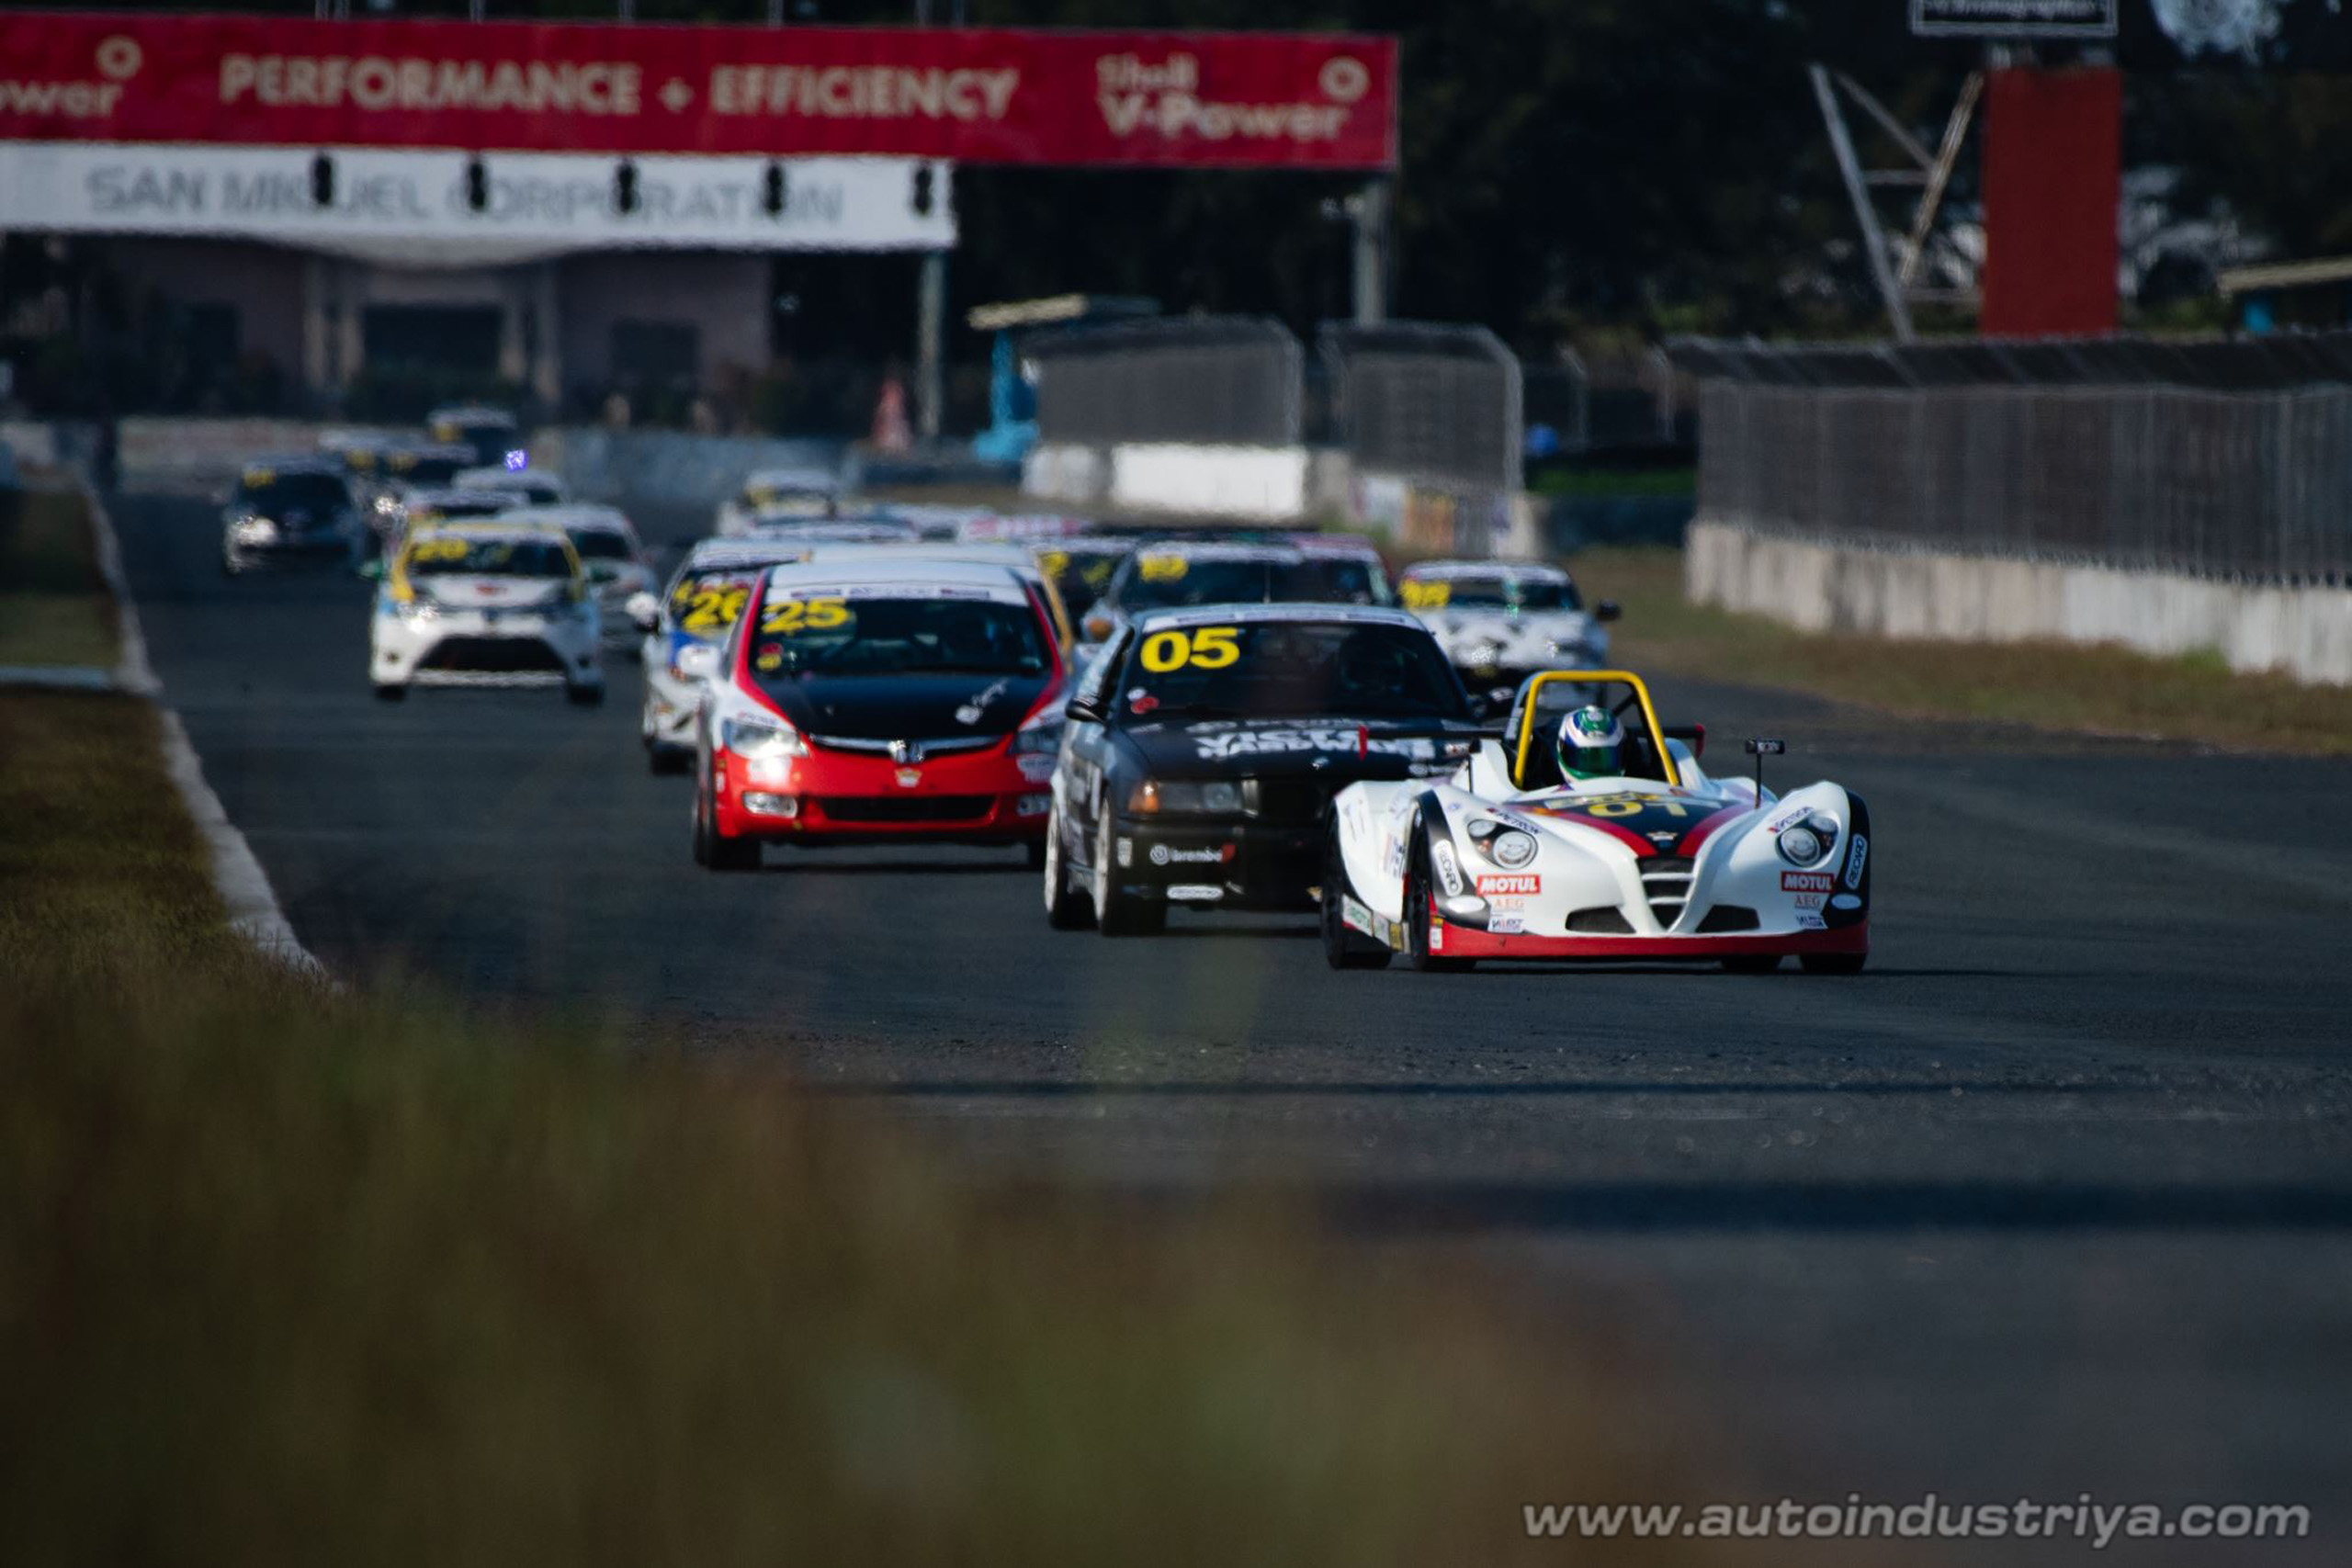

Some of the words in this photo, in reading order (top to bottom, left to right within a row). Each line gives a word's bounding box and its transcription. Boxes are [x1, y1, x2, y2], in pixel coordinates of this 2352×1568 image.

[220, 52, 641, 116] PERFORMANCE
[710, 63, 1020, 120] EFFICIENCY
[1095, 51, 1198, 90] Shell
[1097, 91, 1350, 141] V-Power
[86, 164, 205, 214] SAN
[761, 597, 850, 634] 25
[1140, 626, 1240, 673] 05
[1587, 800, 1689, 818] 01
[1480, 876, 1538, 894] MOTUL
[1783, 874, 1833, 890] MOTUL
